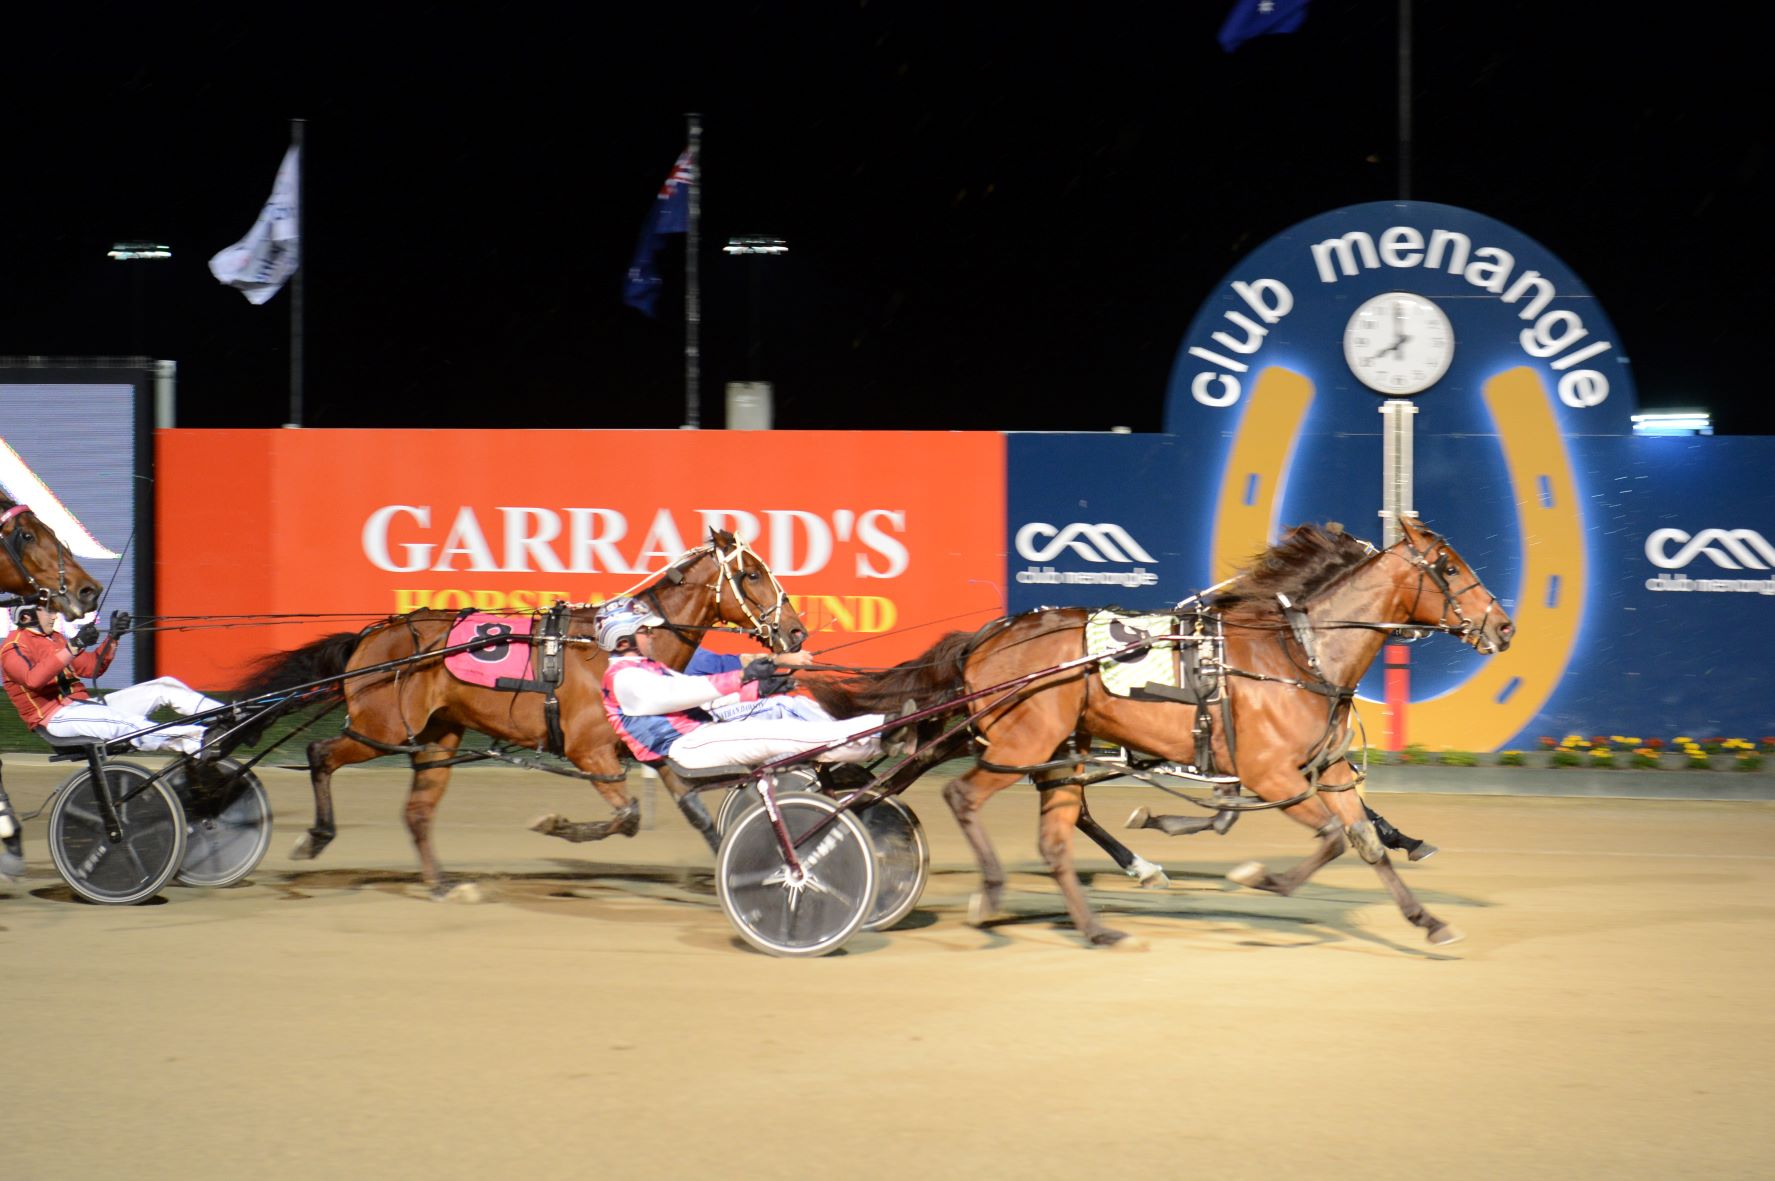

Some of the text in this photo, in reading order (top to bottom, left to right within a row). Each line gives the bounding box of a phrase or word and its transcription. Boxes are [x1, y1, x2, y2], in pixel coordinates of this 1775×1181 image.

[1189, 279, 1294, 408] club
[1310, 226, 1612, 408] menangle
[361, 504, 909, 579] GARRARD'S
[466, 621, 514, 664] 8
